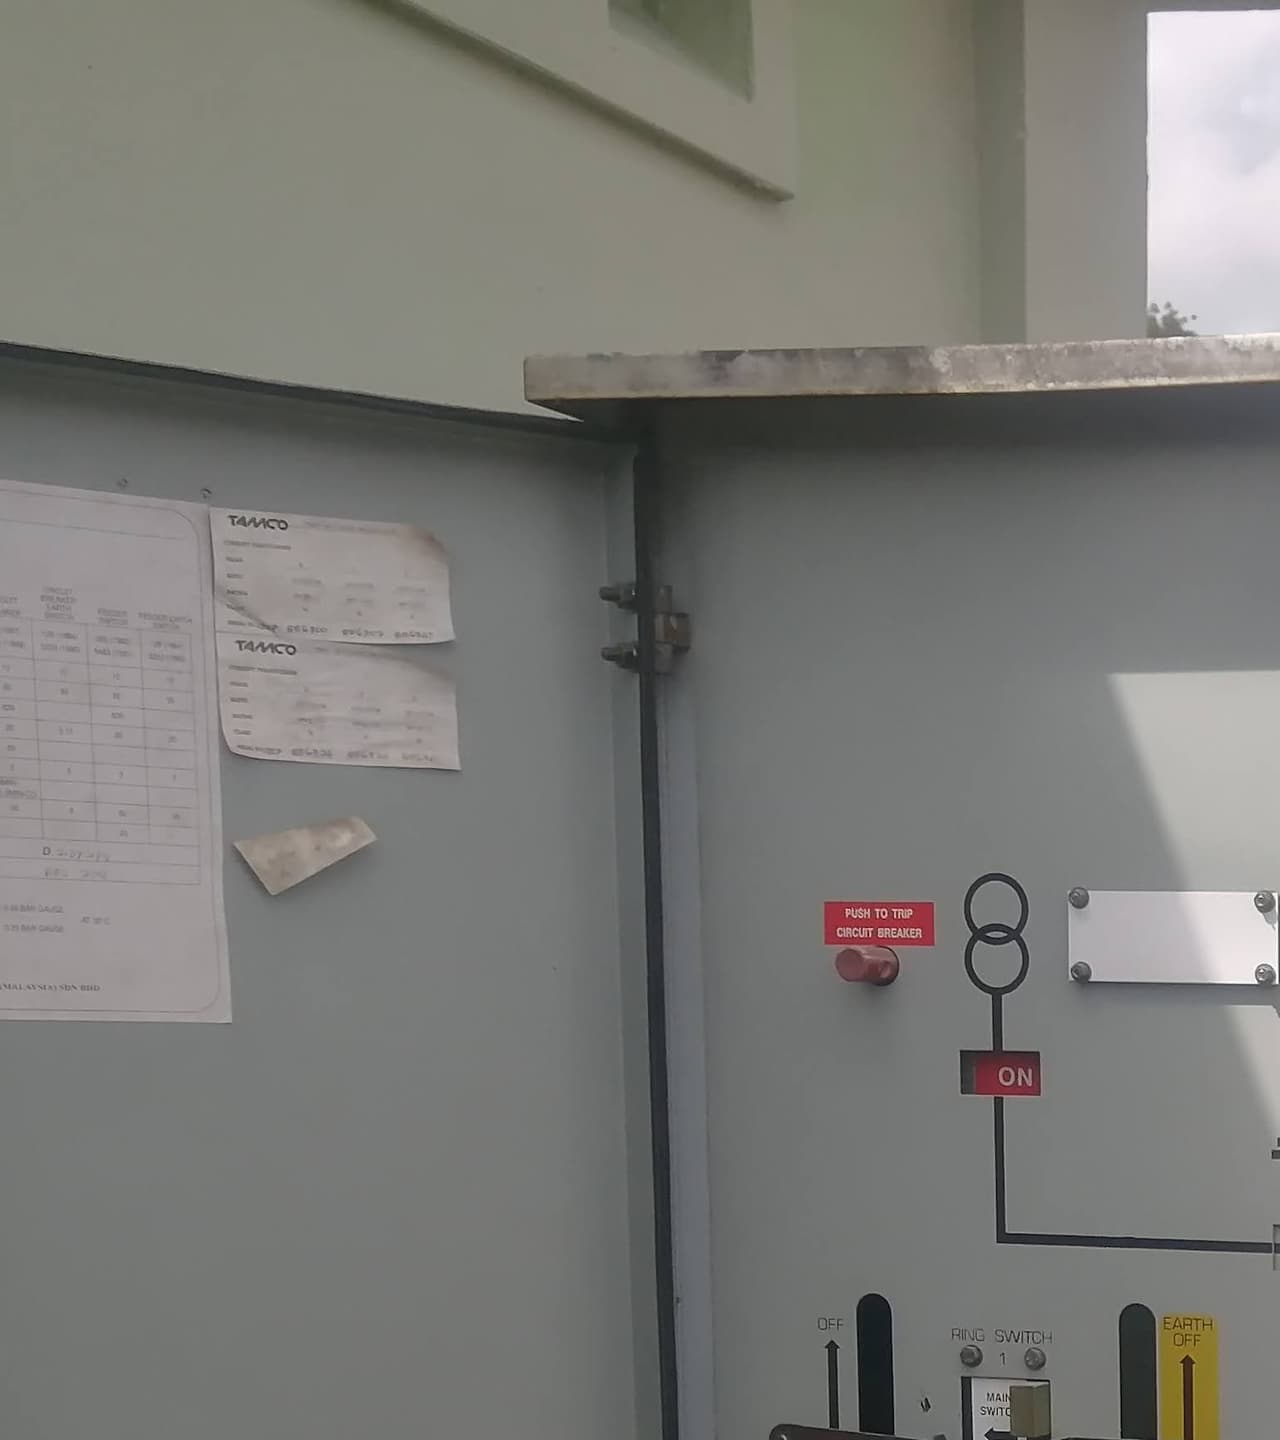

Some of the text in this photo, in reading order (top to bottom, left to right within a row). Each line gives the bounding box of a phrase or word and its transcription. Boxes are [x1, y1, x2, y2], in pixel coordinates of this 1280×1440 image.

[227, 515, 289, 531] TAMCO
[235, 639, 297, 655] TAMCO
[844, 908, 914, 919] PUSH TO TRIP
[836, 927, 922, 939] CIRCUIT BREAKER
[998, 1067, 1033, 1087] ON
[817, 1317, 844, 1331] OFF
[1162, 1316, 1214, 1332] EARTH
[951, 1327, 1053, 1345] RING SWITCH
[1172, 1332, 1201, 1347] OFF
[1000, 1352, 1006, 1366] 1
